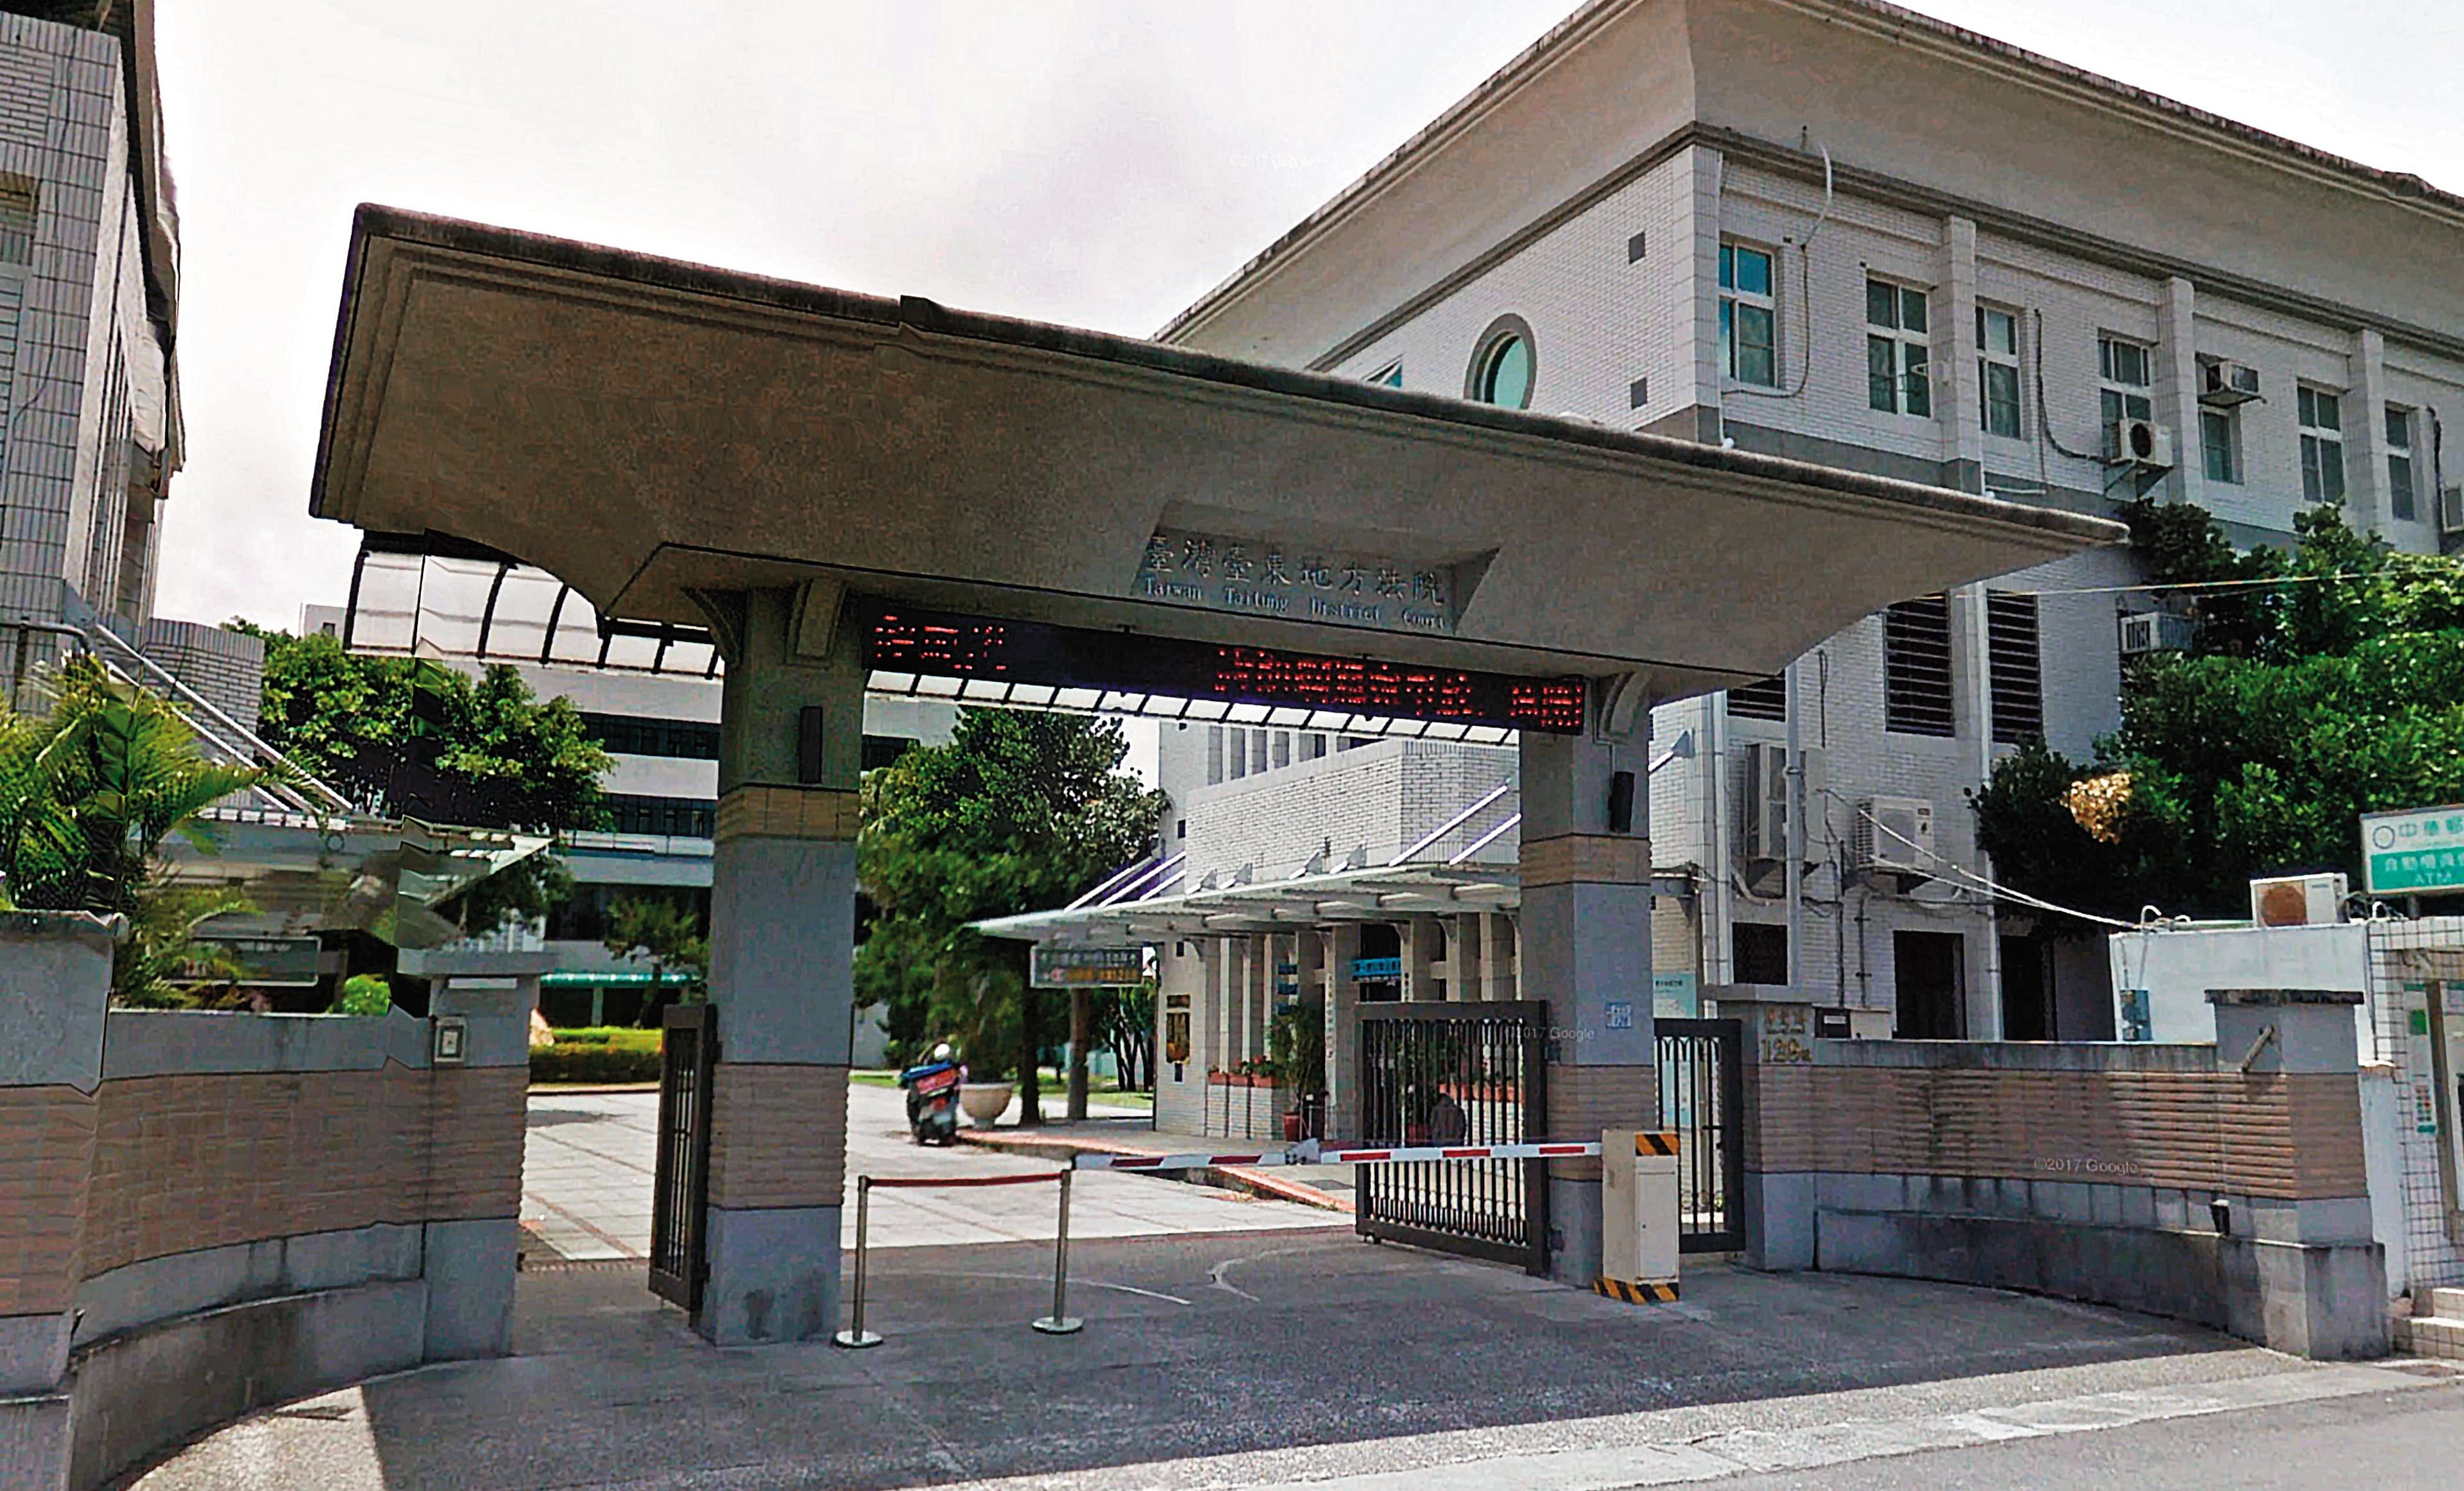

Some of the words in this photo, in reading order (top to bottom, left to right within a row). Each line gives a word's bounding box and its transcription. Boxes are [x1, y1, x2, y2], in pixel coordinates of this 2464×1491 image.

[1145, 576, 1202, 601] Taiwan
[1225, 587, 1289, 613] Taitung
[1310, 598, 1380, 623] District
[1402, 608, 1444, 629] Court
